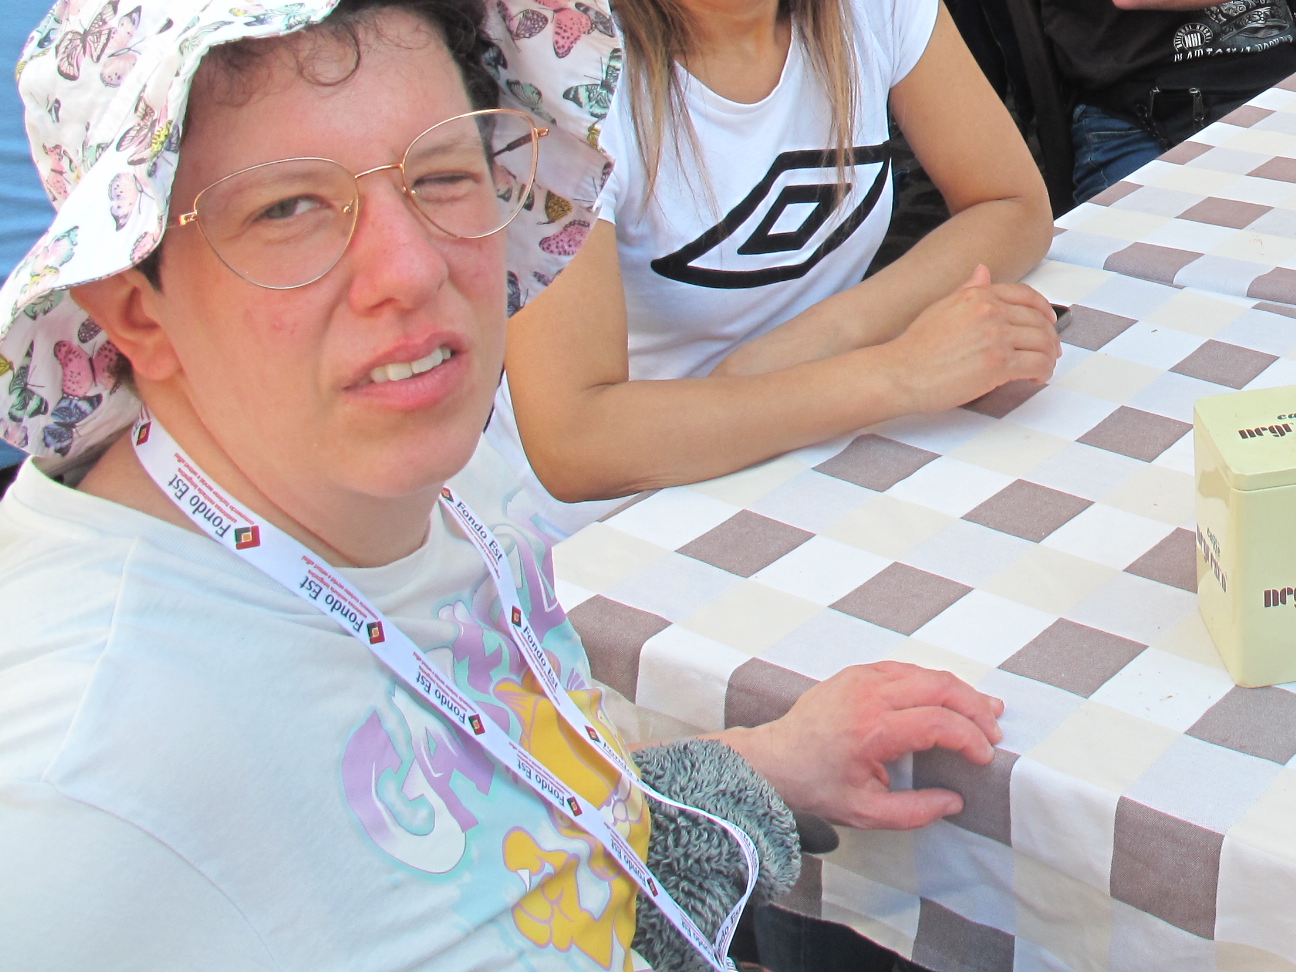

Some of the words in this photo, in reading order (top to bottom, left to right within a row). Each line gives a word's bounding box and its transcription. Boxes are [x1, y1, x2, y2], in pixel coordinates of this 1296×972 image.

[168, 474, 190, 501] Est
[189, 495, 232, 538] Fondo
[456, 501, 488, 539] Fondo
[488, 539, 503, 561] Est
[299, 575, 323, 601] Est
[325, 594, 364, 633] Fondo
[523, 626, 547, 667] Fondo
[547, 668, 559, 690] Est
[416, 671, 432, 694] Est
[435, 689, 466, 724] Fondo
[517, 759, 532, 779] Est
[535, 774, 565, 807] Fondo
